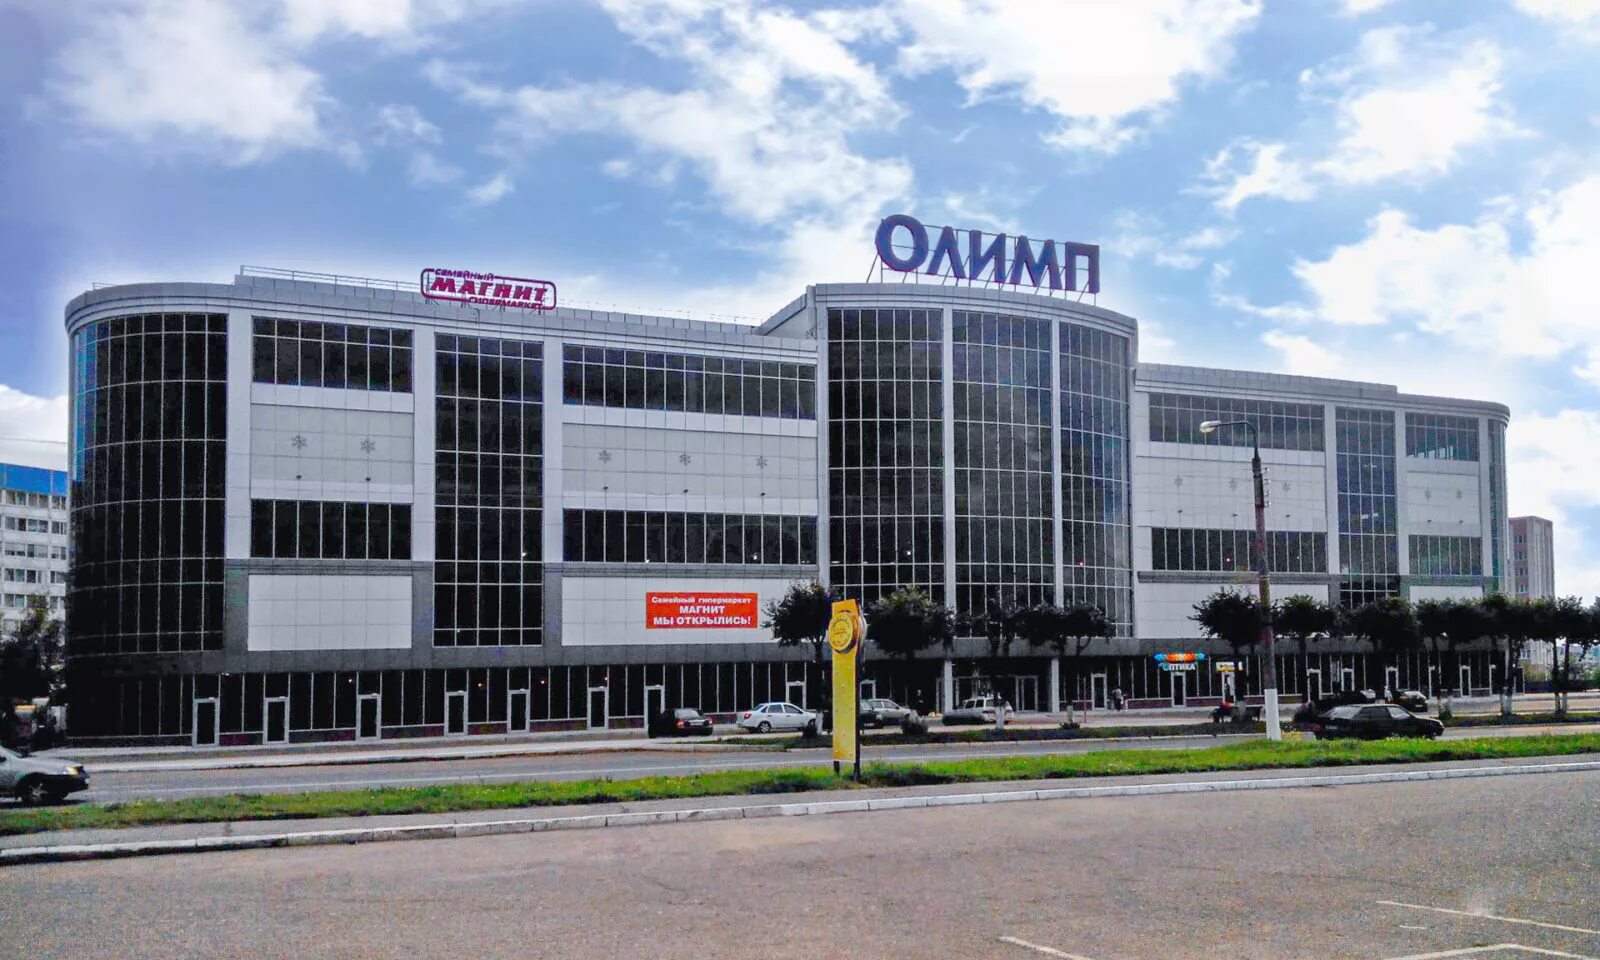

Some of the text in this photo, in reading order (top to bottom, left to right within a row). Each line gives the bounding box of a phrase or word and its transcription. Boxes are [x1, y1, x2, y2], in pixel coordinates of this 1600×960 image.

[875, 214, 1100, 294] ОЛИМП
[430, 277, 547, 301] МАГНИТ
[651, 596, 695, 604] Семейный
[679, 605, 725, 614] МАГНИТ
[653, 616, 751, 625] МЫ ОТКРЫЛИСЬ!
[1162, 662, 1196, 671] ОПТИКА
